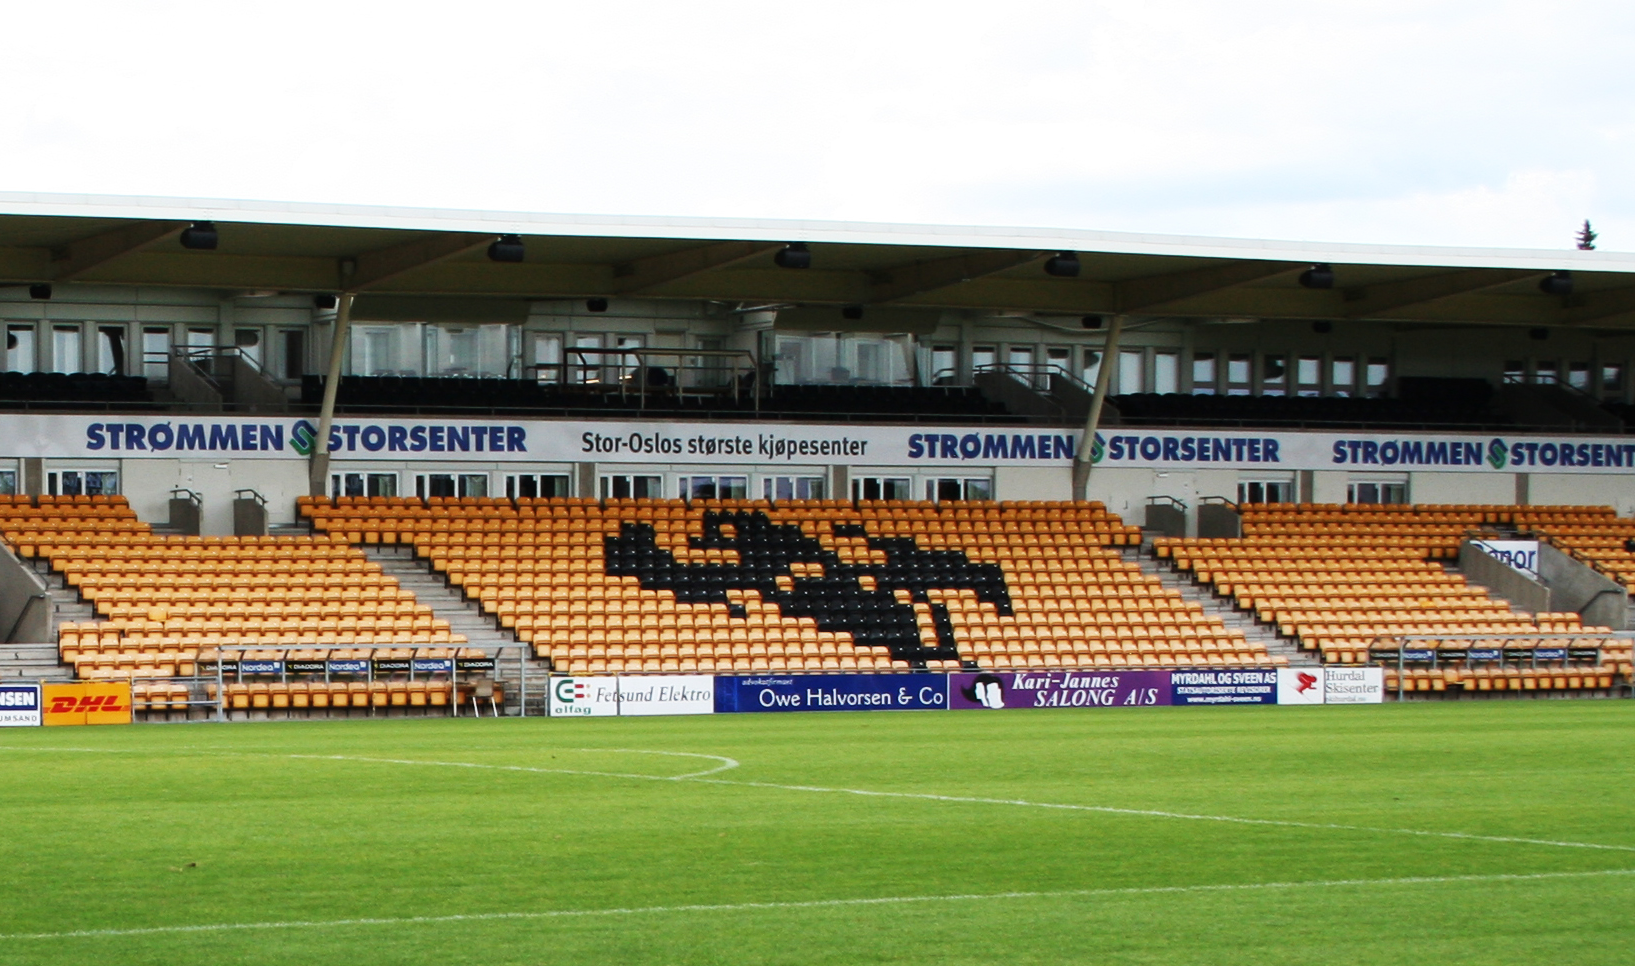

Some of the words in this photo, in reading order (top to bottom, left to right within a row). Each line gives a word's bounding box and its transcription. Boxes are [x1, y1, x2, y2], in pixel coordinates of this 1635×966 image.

[86, 421, 284, 452] STRØMMEN
[327, 424, 527, 452] STORSENTER
[582, 431, 682, 454] Stor-Oslos
[687, 434, 753, 456] største
[759, 434, 868, 460] kjøpesenter
[908, 431, 1075, 460] STRØMMEN
[1109, 435, 1280, 462] STORSENTER
[1332, 439, 1482, 466] STRØMMEN
[242, 661, 274, 671] Nordea
[328, 661, 360, 671] Nordea
[414, 660, 445, 670] Nordea
[1012, 673, 1120, 690] Kari-Jannes
[1171, 672, 1217, 685] MYRDAHL
[1218, 672, 1232, 684] OG
[1233, 672, 1263, 684] SVEEN
[1264, 672, 1277, 684] AS
[1325, 670, 1365, 681] Hurdal
[659, 686, 711, 702] Elektro
[1325, 682, 1378, 693] Skisenter
[50, 695, 123, 714] DHL
[759, 689, 801, 707] Owe
[807, 688, 892, 706] Halvorsen
[898, 687, 913, 704] &
[919, 687, 944, 704] Co
[1034, 689, 1115, 707] SALONG
[1124, 688, 1159, 705] A/S
